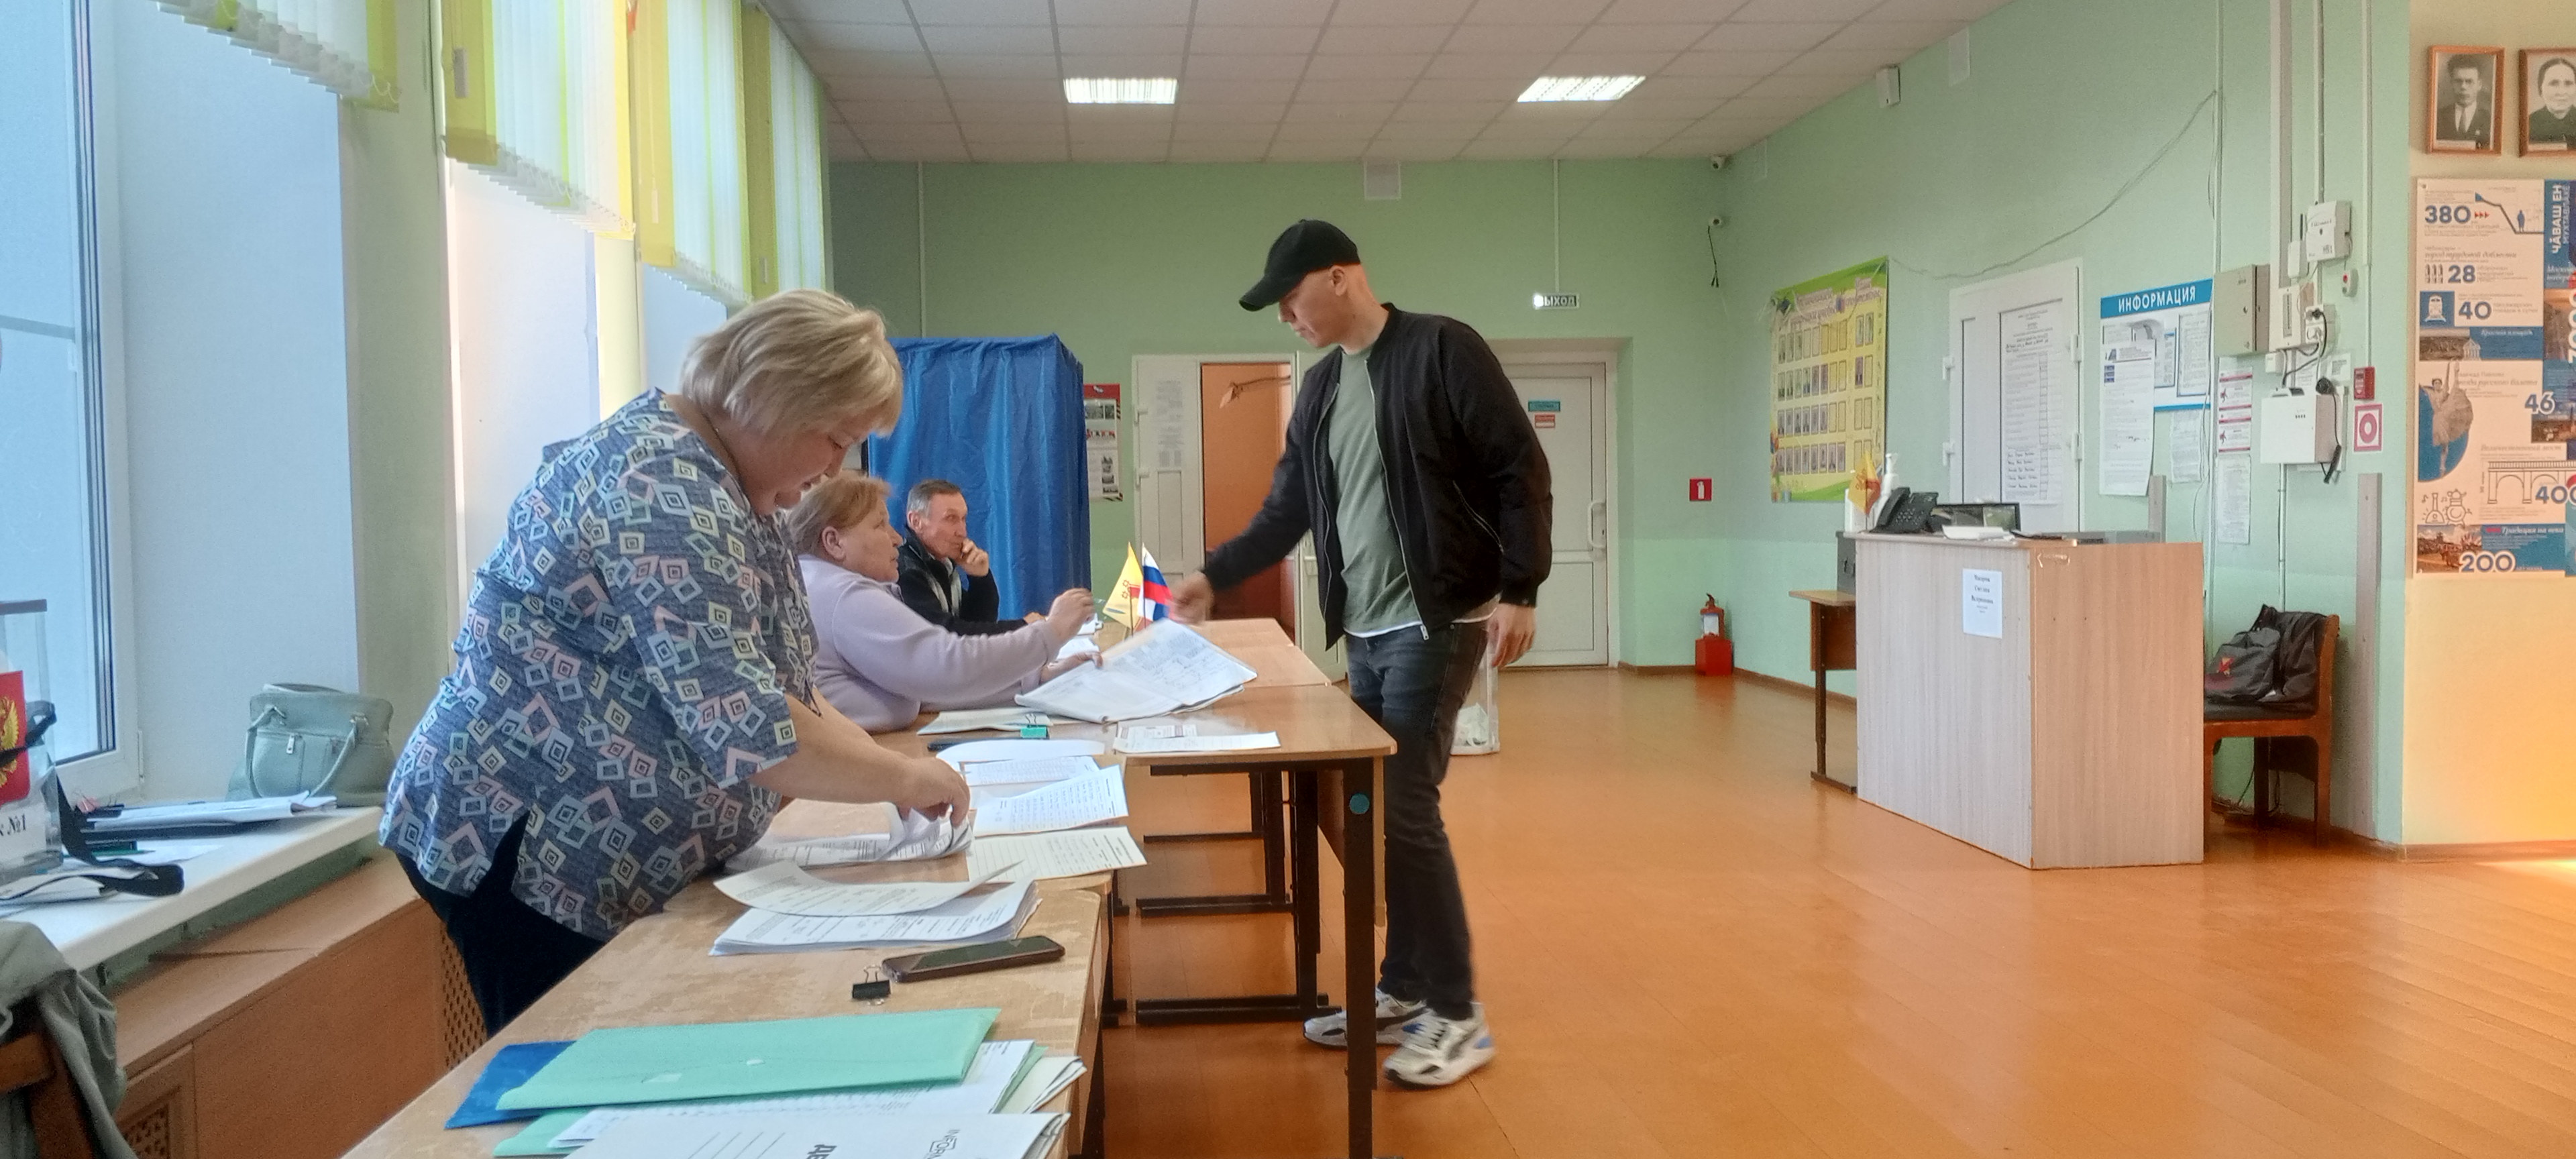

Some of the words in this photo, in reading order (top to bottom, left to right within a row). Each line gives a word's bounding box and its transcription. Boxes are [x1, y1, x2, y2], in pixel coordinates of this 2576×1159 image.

[2552, 184, 2562, 201] ЕН
[2424, 205, 2471, 224] 380
[2448, 265, 2475, 284] 28
[1534, 295, 1575, 307] ЫХОД
[2118, 285, 2196, 313] ИНФОРМАЦИЯ
[2459, 301, 2492, 321] 40
[2524, 392, 2555, 414] 46
[2461, 553, 2513, 571] 200
